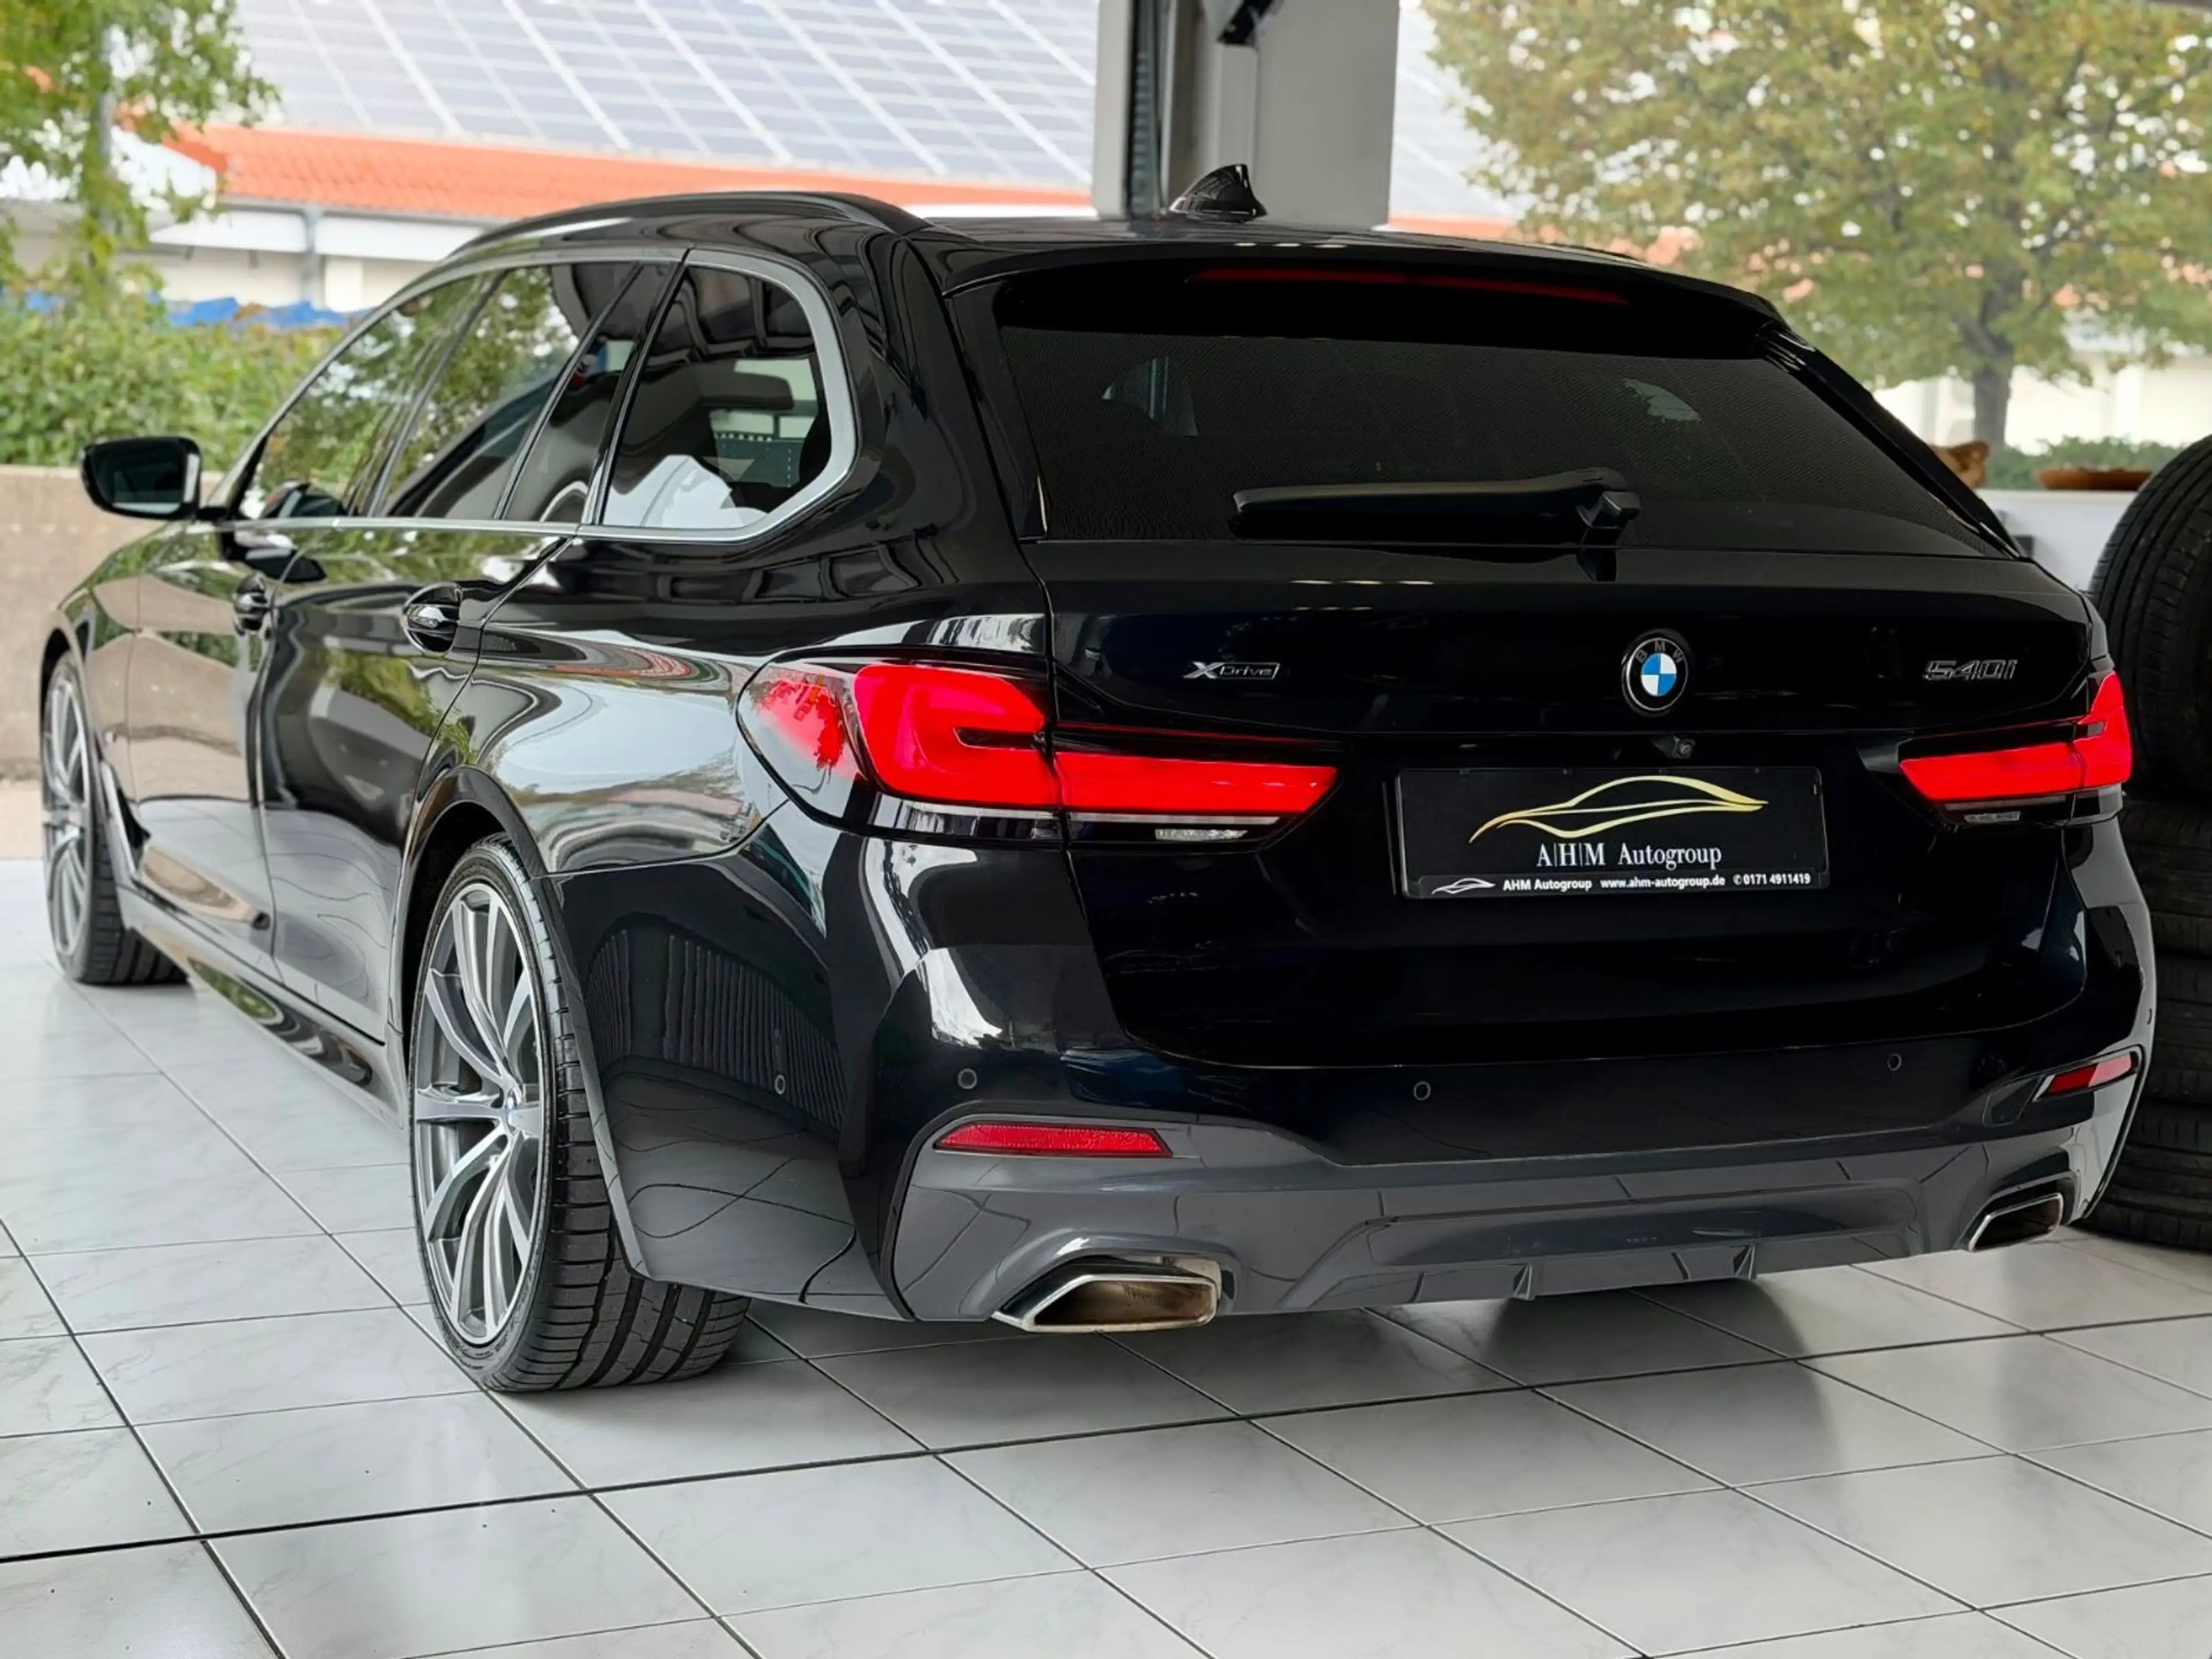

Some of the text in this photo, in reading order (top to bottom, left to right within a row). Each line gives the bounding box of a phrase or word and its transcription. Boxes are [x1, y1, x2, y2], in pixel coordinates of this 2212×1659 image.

[1635, 640, 1685, 664] BMW
[1922, 659, 2018, 680] 540i
[1618, 842, 1722, 870] Autogroup
[1502, 872, 1811, 892] AHM Autogroup www.ahm-autogroup.de 0171 4911419
